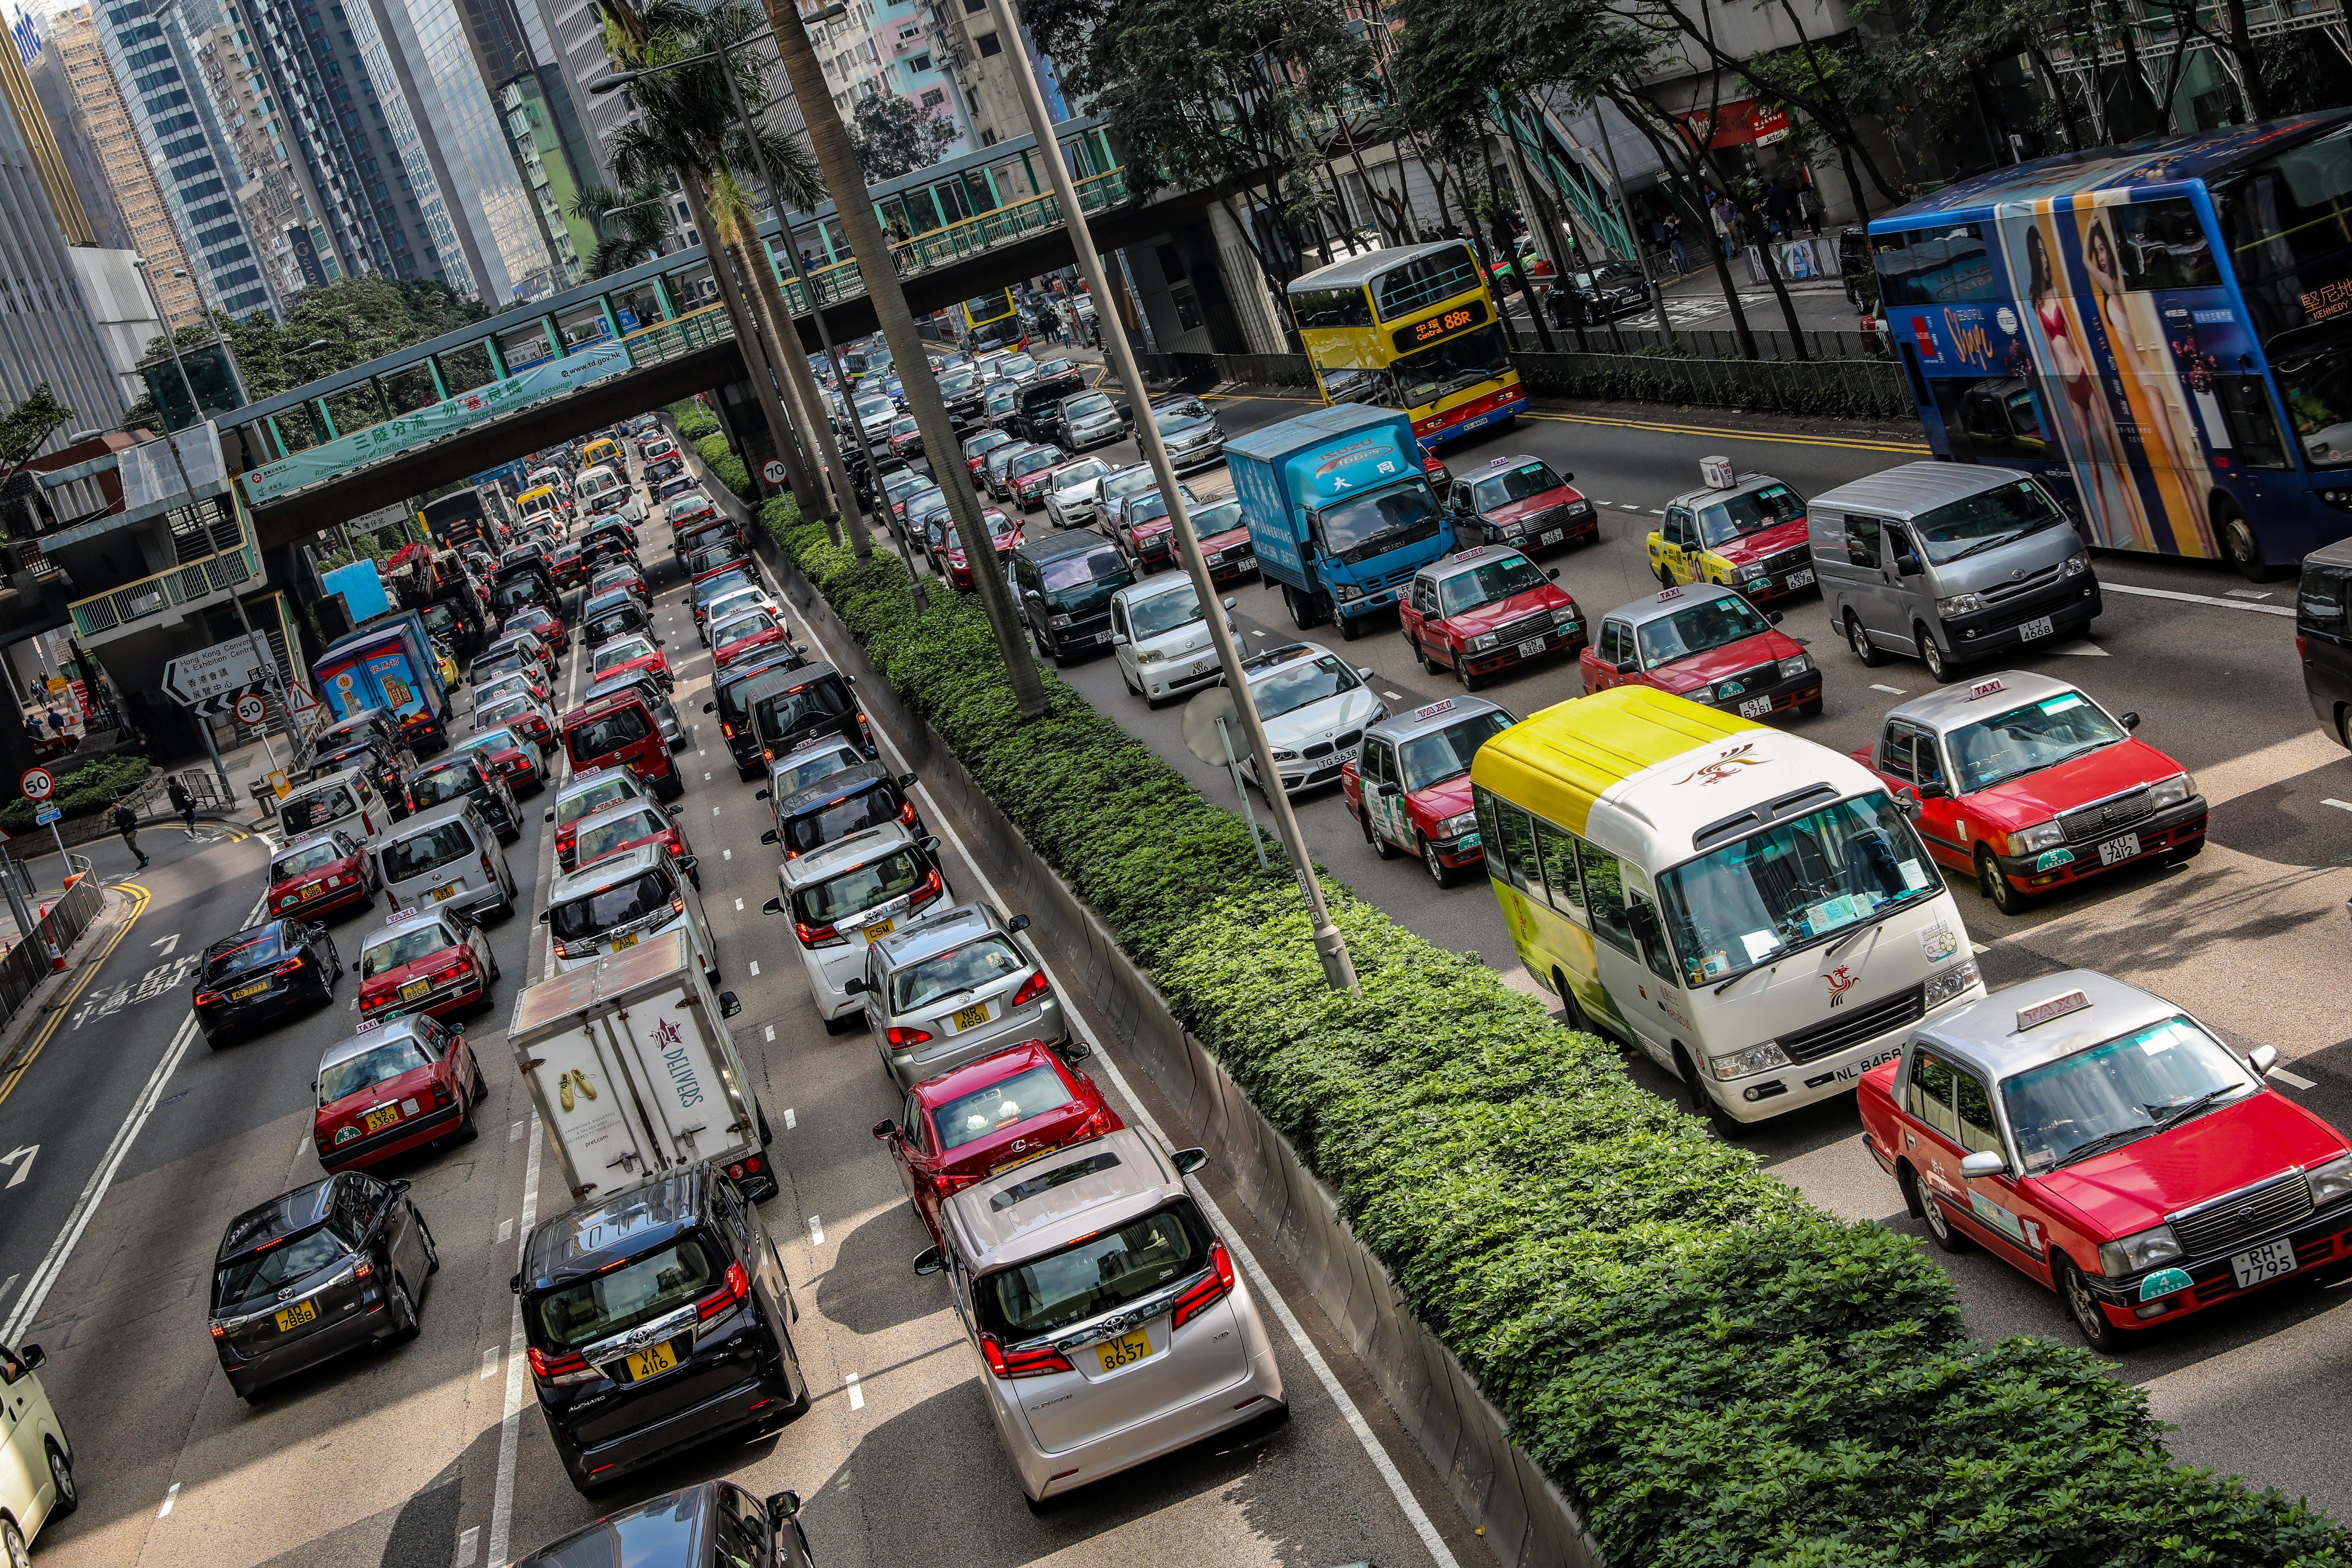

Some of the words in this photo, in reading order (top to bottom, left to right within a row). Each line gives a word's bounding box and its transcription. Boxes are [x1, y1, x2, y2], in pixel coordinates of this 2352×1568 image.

[2301, 279, 2352, 313] 堅尼地
[2314, 300, 2349, 320] KENNEDY
[1416, 319, 1440, 333] 中環
[1445, 311, 1472, 329] 88R
[1417, 327, 1443, 340] Central
[569, 352, 621, 374] www.td.gov.hk
[353, 414, 427, 451] 三隧分流
[443, 380, 522, 418] 勿「塞」良機
[315, 453, 366, 477] Rationalisation
[377, 442, 400, 455] Traffic
[402, 427, 443, 446] Distribution
[445, 418, 468, 430] among
[470, 409, 489, 420] Three
[492, 404, 509, 414] Road
[511, 393, 539, 407] Harbour
[541, 380, 573, 396] Crossings
[1320, 438, 1373, 460] ISUZU
[1338, 450, 1380, 466] 166PS
[766, 464, 785, 478] 70
[1724, 469, 1732, 480] 的士
[386, 504, 401, 513] North
[1544, 534, 1562, 544] 2087
[1380, 540, 1405, 553] ISUZU
[1456, 547, 1483, 561] TAXI
[379, 561, 387, 569] 70
[1791, 576, 1812, 588] 6378
[1793, 571, 1805, 580] MG
[1401, 584, 1410, 592] FF
[1660, 588, 1679, 599] TAXI
[2027, 620, 2041, 630] LJ
[2023, 625, 2050, 640] 4668
[180, 656, 199, 667] Hong
[202, 649, 221, 659] Kong
[224, 634, 264, 652] Convenon
[1522, 644, 1544, 656] 9468
[1525, 640, 1536, 648] SN
[193, 655, 227, 671] Exhibition
[231, 646, 255, 658] Centre
[1192, 665, 1208, 675] 4316
[188, 668, 229, 688] 香港會議
[192, 681, 233, 700] 展覽中心
[1975, 681, 2000, 695] TAXI
[1418, 700, 1452, 717] TAXI
[1748, 697, 1761, 707] GT
[240, 701, 261, 718] 50
[1744, 703, 1770, 719] 6761
[798, 739, 813, 748] TAXI
[1320, 758, 1332, 767] TG
[1335, 749, 1357, 763] 5638
[576, 767, 598, 779] TAXI
[25, 776, 49, 794] 50
[598, 797, 622, 810] TAXI
[1464, 840, 1481, 849] SEATS
[2110, 837, 2126, 849] KU
[2050, 853, 2058, 862] 5
[2107, 846, 2133, 863] 7412
[2045, 858, 2067, 868] SEATS
[437, 891, 454, 901] 4681
[388, 908, 414, 922] TAXI
[870, 924, 890, 938] CSM
[235, 990, 245, 999] AD
[246, 983, 264, 994] 7777
[407, 986, 427, 999] 8805
[409, 982, 419, 991] VF
[961, 1007, 976, 1019] NR
[2024, 991, 2084, 1024] TAXI
[961, 1013, 986, 1028] 4691
[1664, 1002, 1692, 1032] Rehabus
[358, 1019, 377, 1032] TAXI
[651, 1021, 682, 1048] PRET
[1836, 1069, 1858, 1083] NL
[1860, 1046, 1902, 1072] 8468
[663, 1047, 704, 1108] DELIVERS
[374, 1109, 387, 1119] LB
[372, 1114, 395, 1129] 3369
[565, 1121, 590, 1134] SANDWICHES,
[592, 1112, 615, 1124] BAGUETTES
[566, 1133, 588, 1145] DELIVERED
[607, 1120, 621, 1129] OFFICE
[580, 1125, 596, 1133] SALADS
[341, 1134, 356, 1142] SEATS
[585, 1134, 609, 1148] pret.com
[718, 1158, 732, 1167] 2760
[733, 1152, 747, 1160] 9933
[2250, 1244, 2276, 1265] RH
[2149, 1269, 2171, 1279] TAXI
[2240, 1256, 2291, 1285] 7795
[2160, 1276, 2169, 1287] 4
[2150, 1282, 2183, 1296] SEATS
[287, 1305, 302, 1319] AD
[281, 1310, 313, 1330] 7888
[1109, 1337, 1133, 1352] VL
[639, 1348, 661, 1363] VA
[1104, 1342, 1144, 1369] 8657
[641, 1356, 668, 1376] 4116
[569, 1396, 605, 1412] ALPHARD
[1030, 1394, 1073, 1412] ALPHARD
